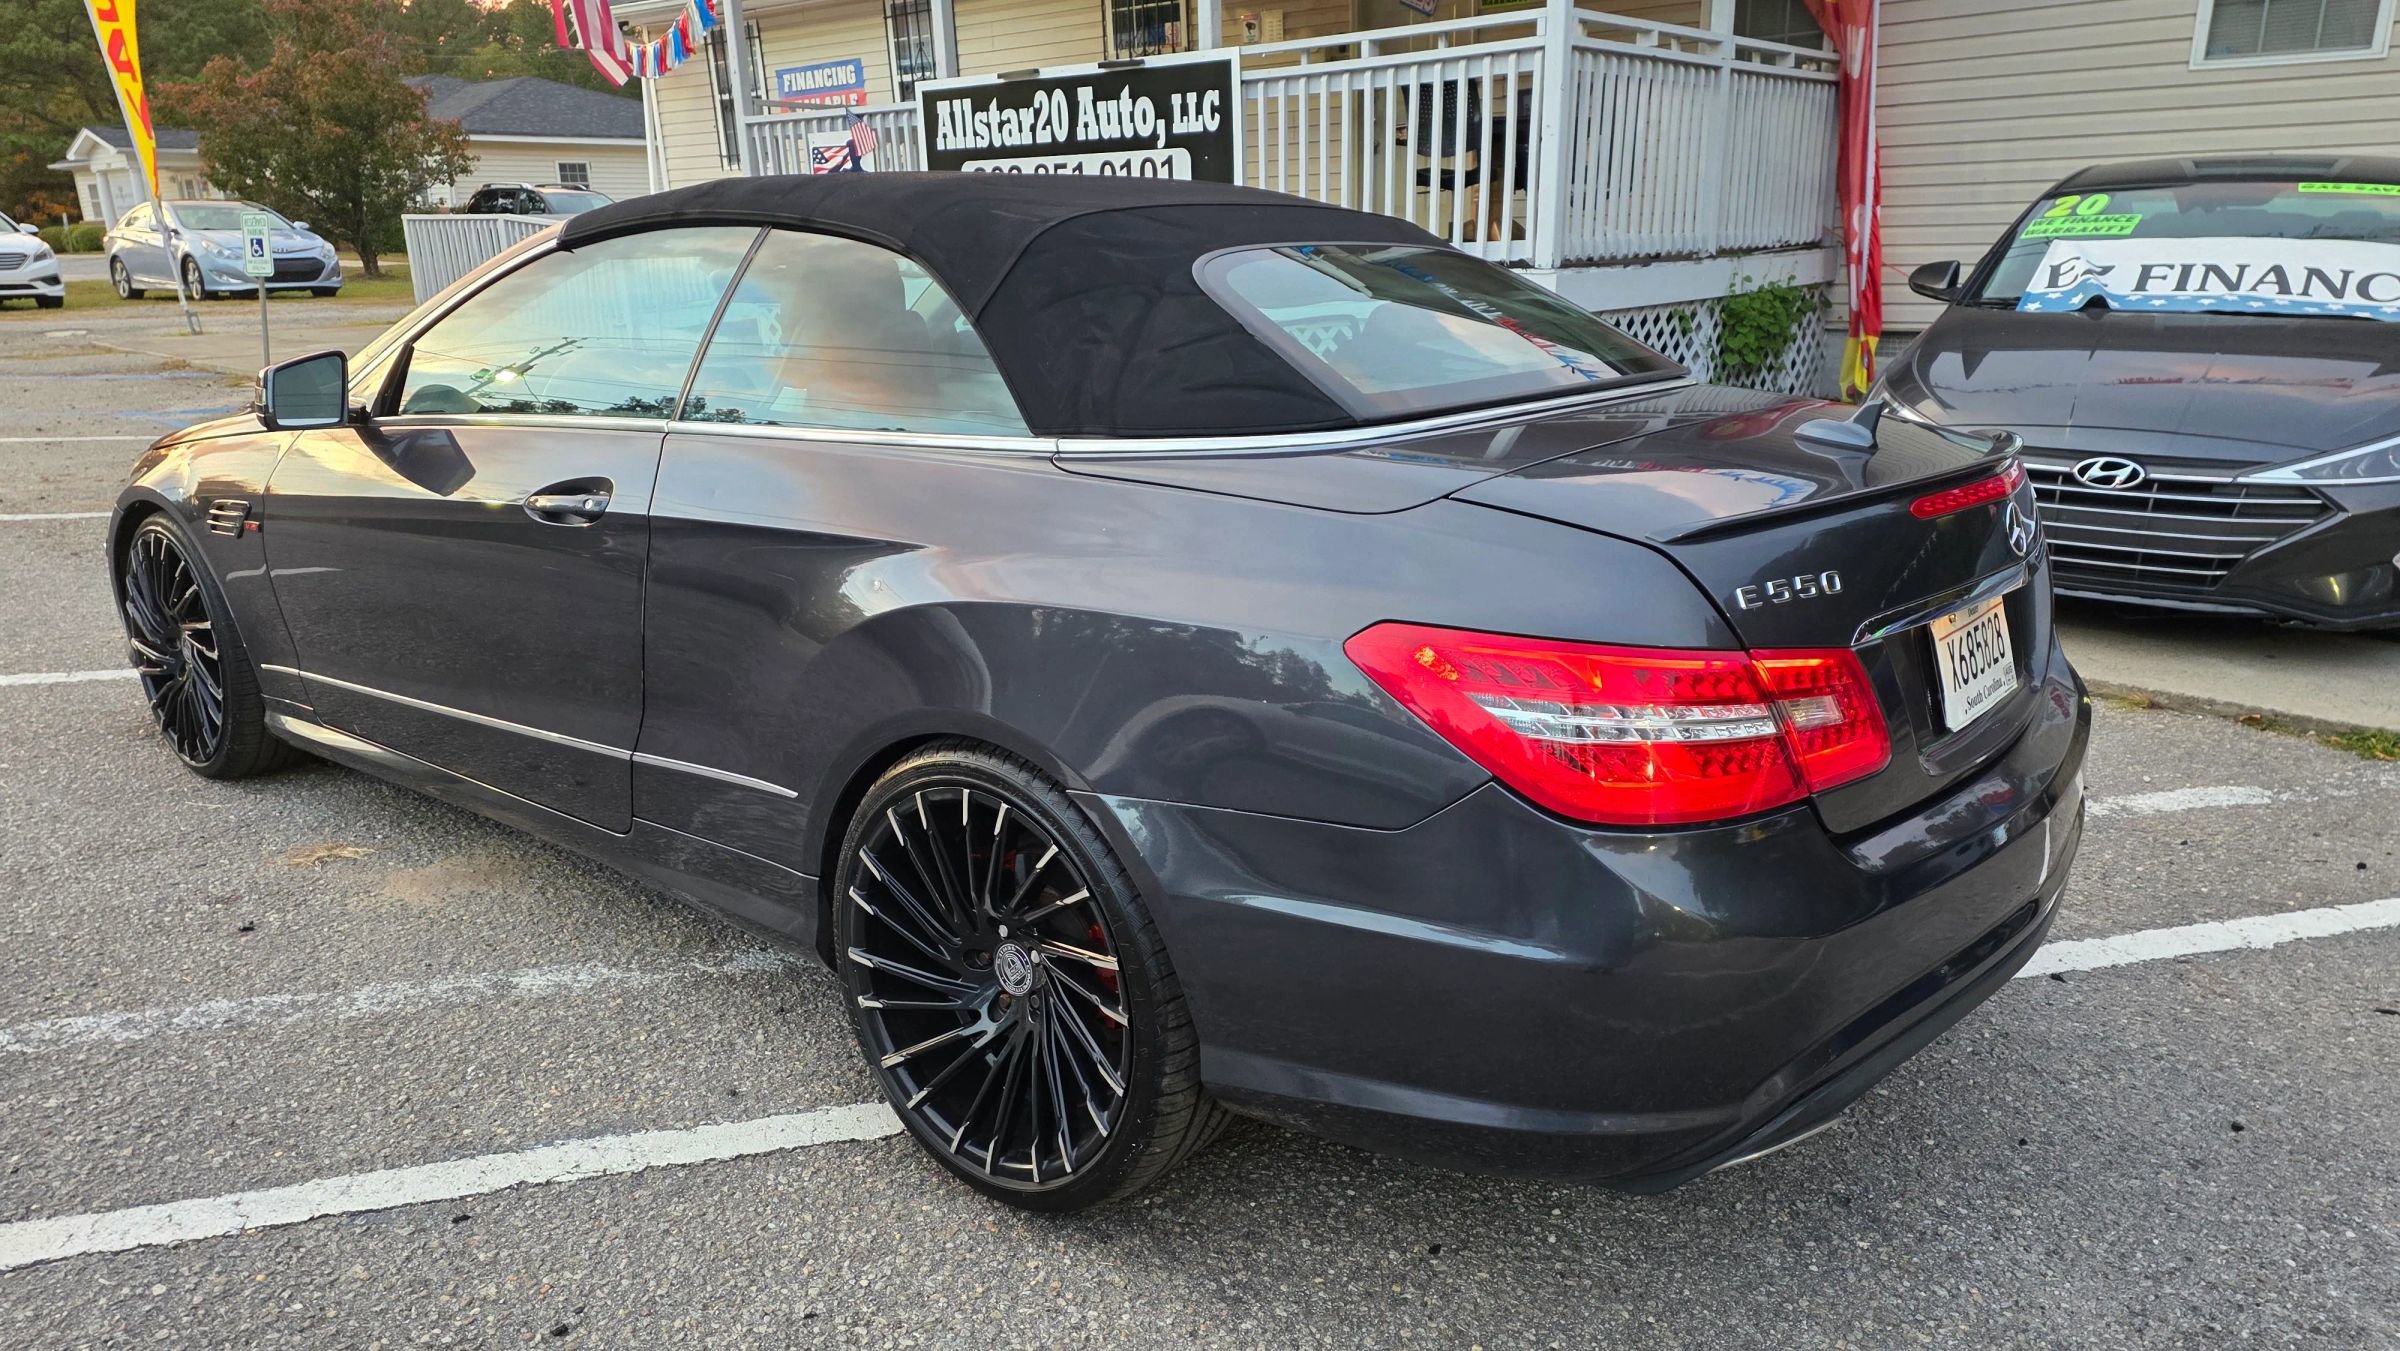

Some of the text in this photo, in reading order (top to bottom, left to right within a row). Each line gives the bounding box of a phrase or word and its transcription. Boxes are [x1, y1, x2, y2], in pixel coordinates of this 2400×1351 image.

[782, 64, 857, 93] FINANCING
[936, 84, 1221, 151] Allstar20 Auto, LLC
[2043, 193, 2109, 217] 20
[2059, 214, 2137, 224] FINANCE
[2023, 225, 2130, 237] WARRANTY
[1736, 570, 1844, 610] E 550
[1947, 612, 2006, 693] X685828
[1966, 677, 2004, 711] South Carolina
